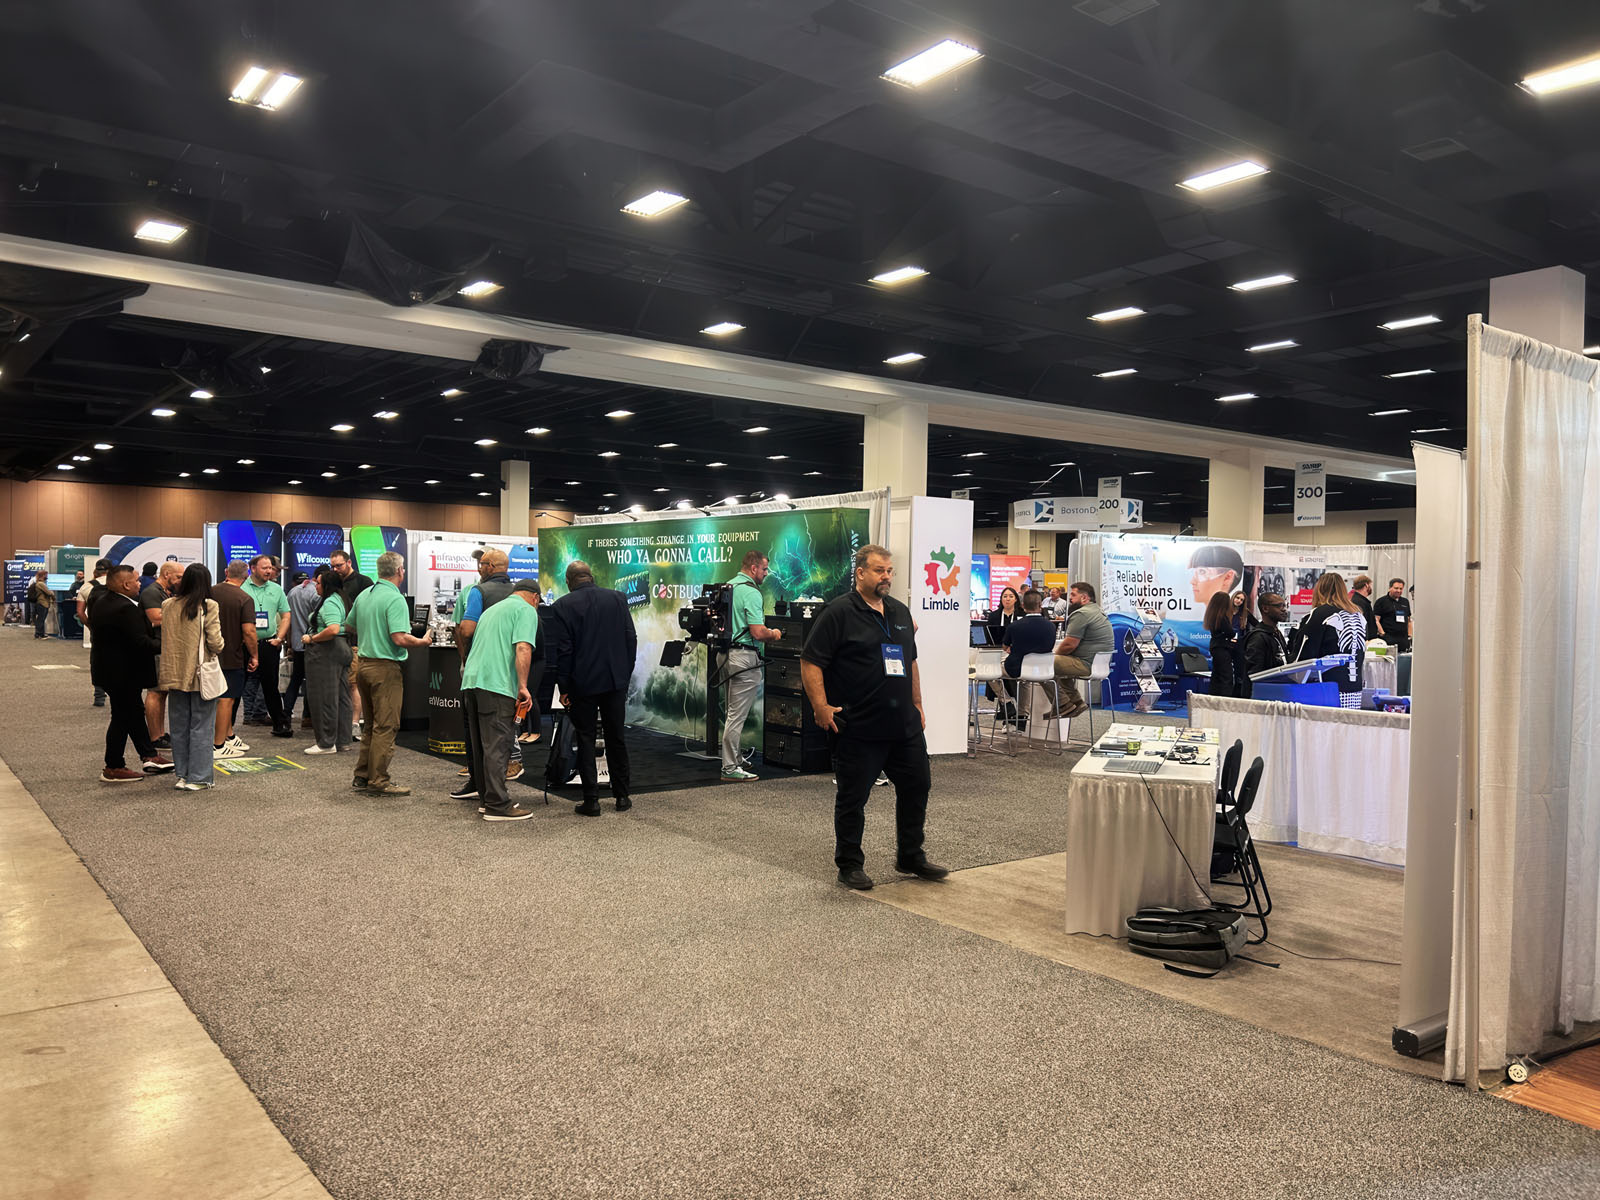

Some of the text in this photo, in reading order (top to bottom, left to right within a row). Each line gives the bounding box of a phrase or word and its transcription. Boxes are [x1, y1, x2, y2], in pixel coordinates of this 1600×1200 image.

[1296, 486, 1323, 499] 300
[1098, 498, 1119, 510] 200
[587, 531, 760, 548] IF THERE'S SOMETHING STRANGE IN YOUR EQUIPMENT
[296, 552, 331, 564] Wilcoxo
[607, 545, 733, 564] WHO YA GONNA CALL?
[1116, 570, 1153, 583] Reliable
[1123, 585, 1173, 597] Solutions
[922, 597, 960, 611] Limble
[1137, 599, 1163, 610] Your
[1167, 599, 1191, 610] OIL
